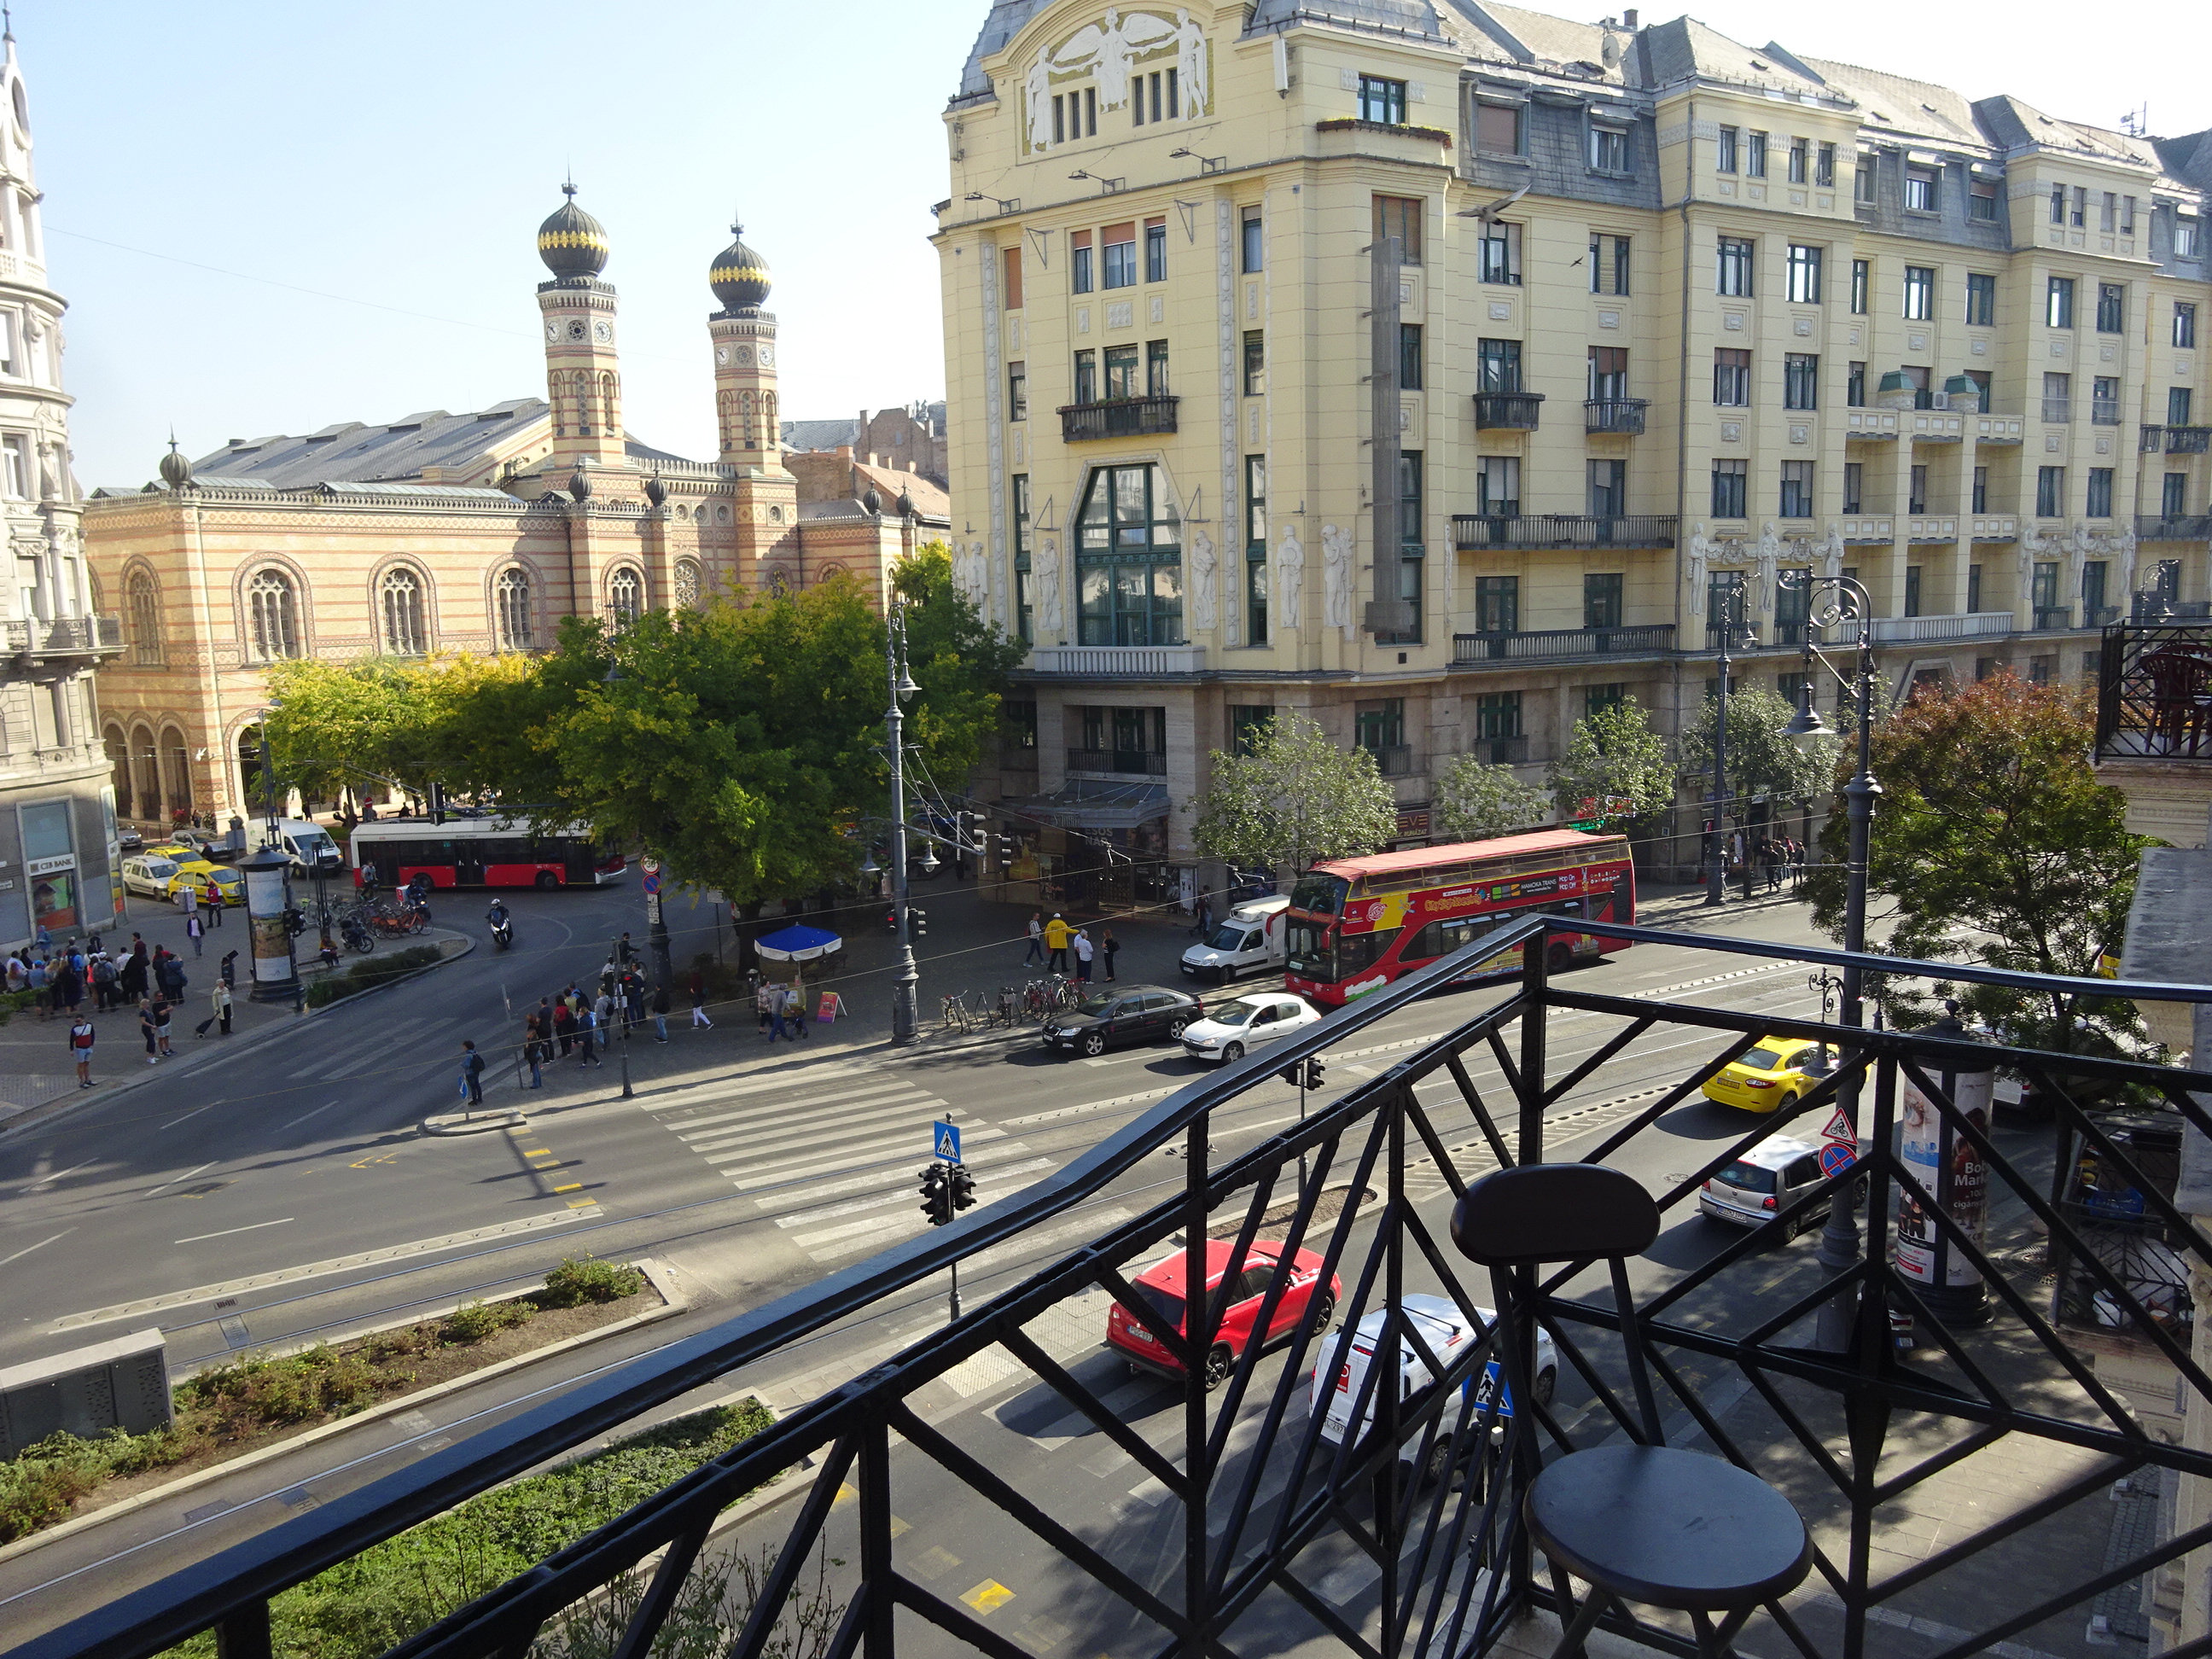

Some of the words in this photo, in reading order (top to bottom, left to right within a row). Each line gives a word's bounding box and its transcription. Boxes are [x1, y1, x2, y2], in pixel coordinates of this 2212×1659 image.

[41, 861, 53, 870] CIB
[55, 859, 73, 867] BANK
[1542, 878, 1557, 887] TRANS
[1324, 1419, 1344, 1433] L-297
